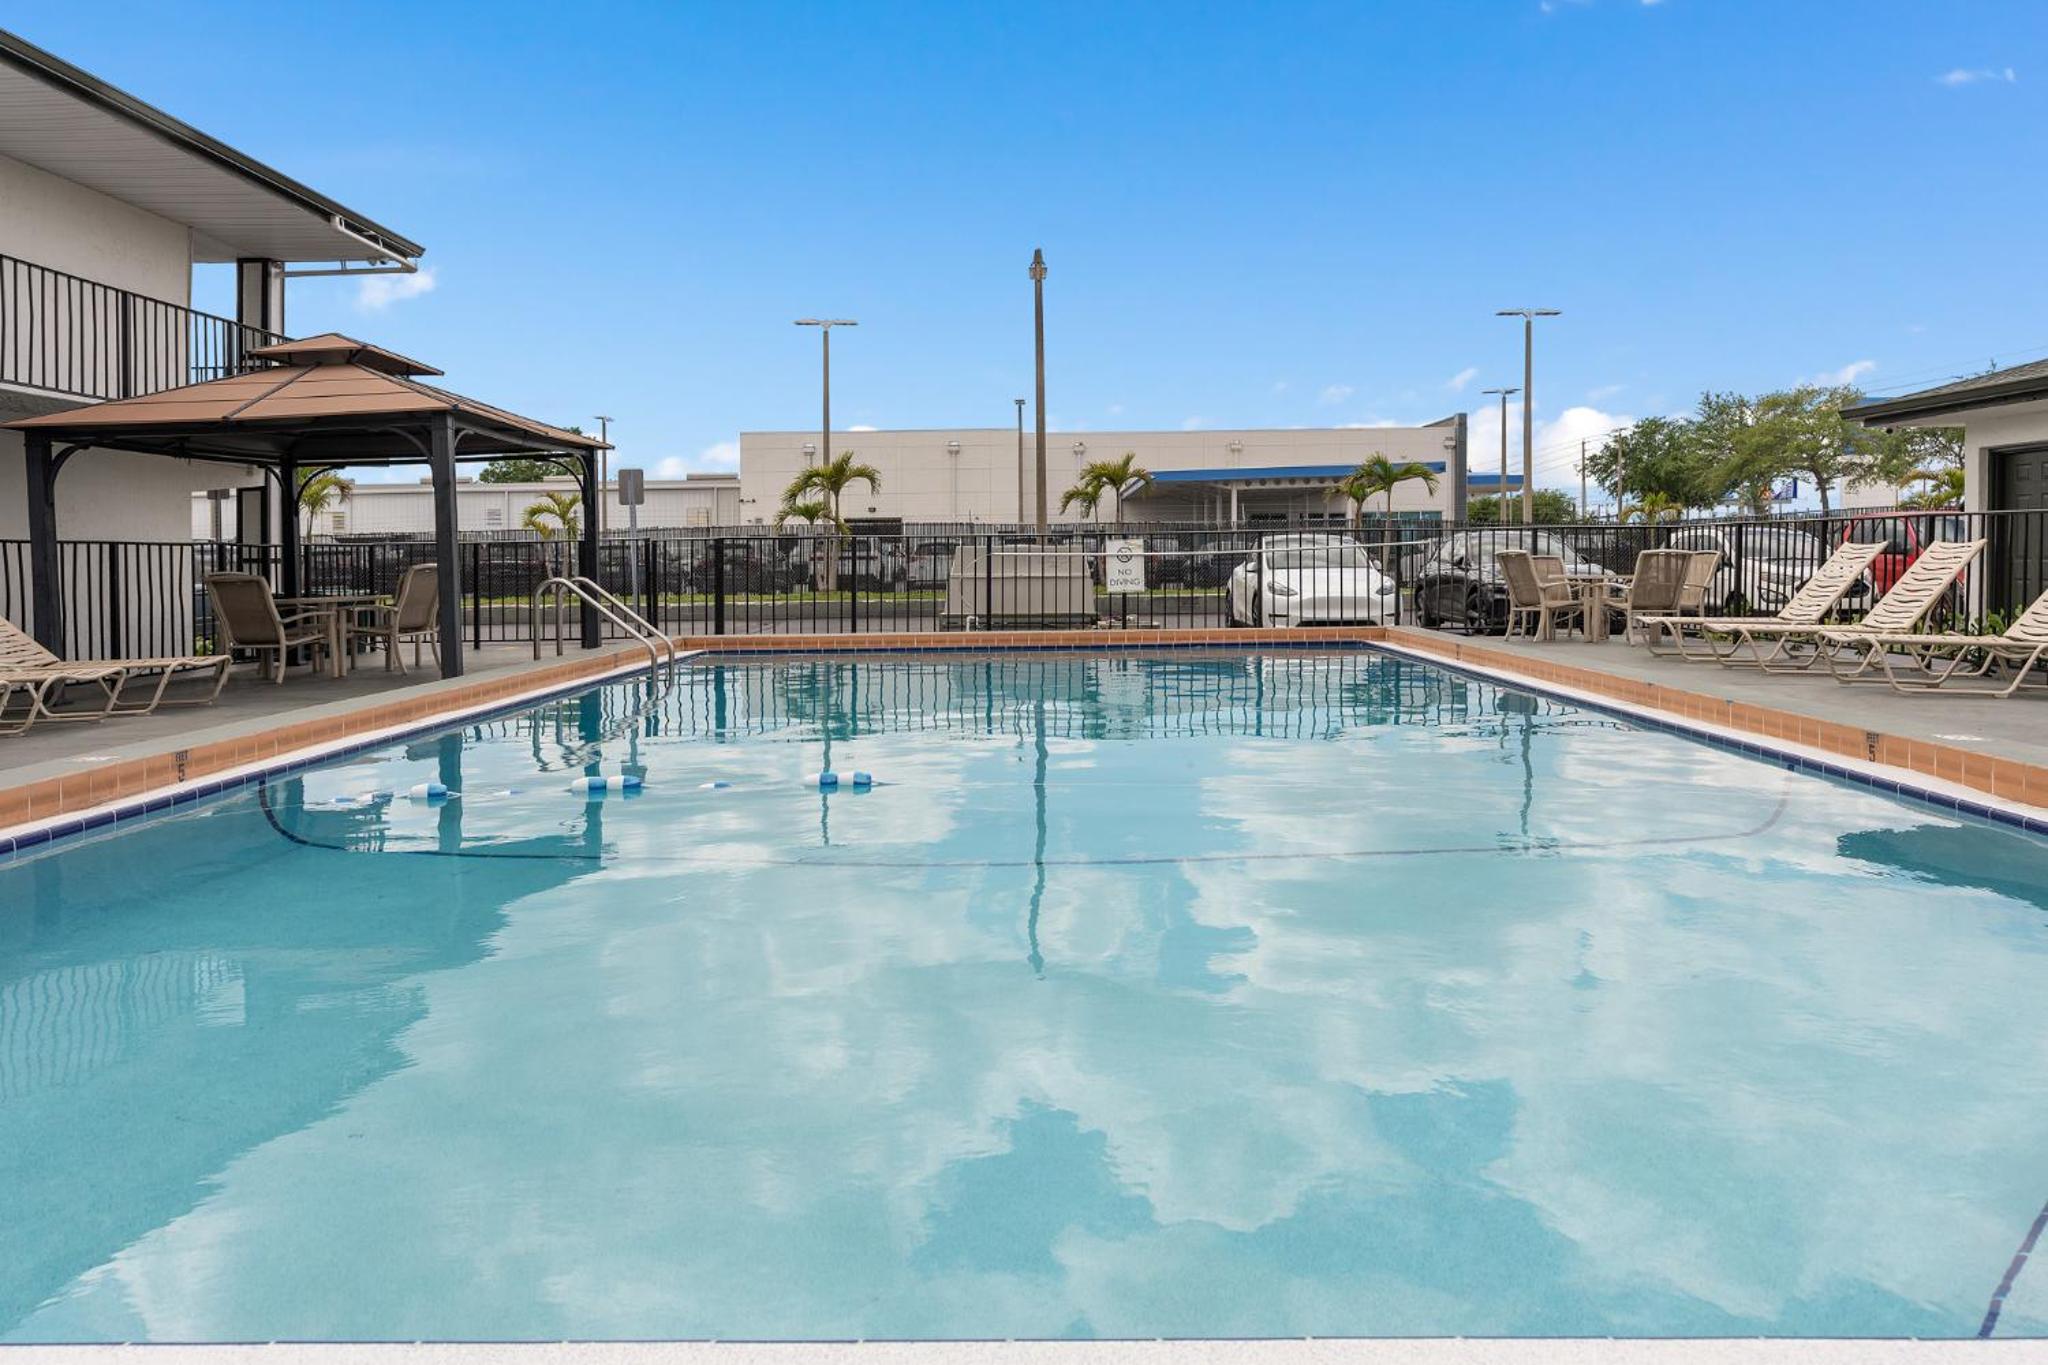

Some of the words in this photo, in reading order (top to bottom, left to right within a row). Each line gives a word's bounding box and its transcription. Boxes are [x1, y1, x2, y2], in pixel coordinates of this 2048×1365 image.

[1110, 578, 1141, 586] DIVING
[1869, 744, 1876, 762] 5
[178, 763, 185, 783] 5
